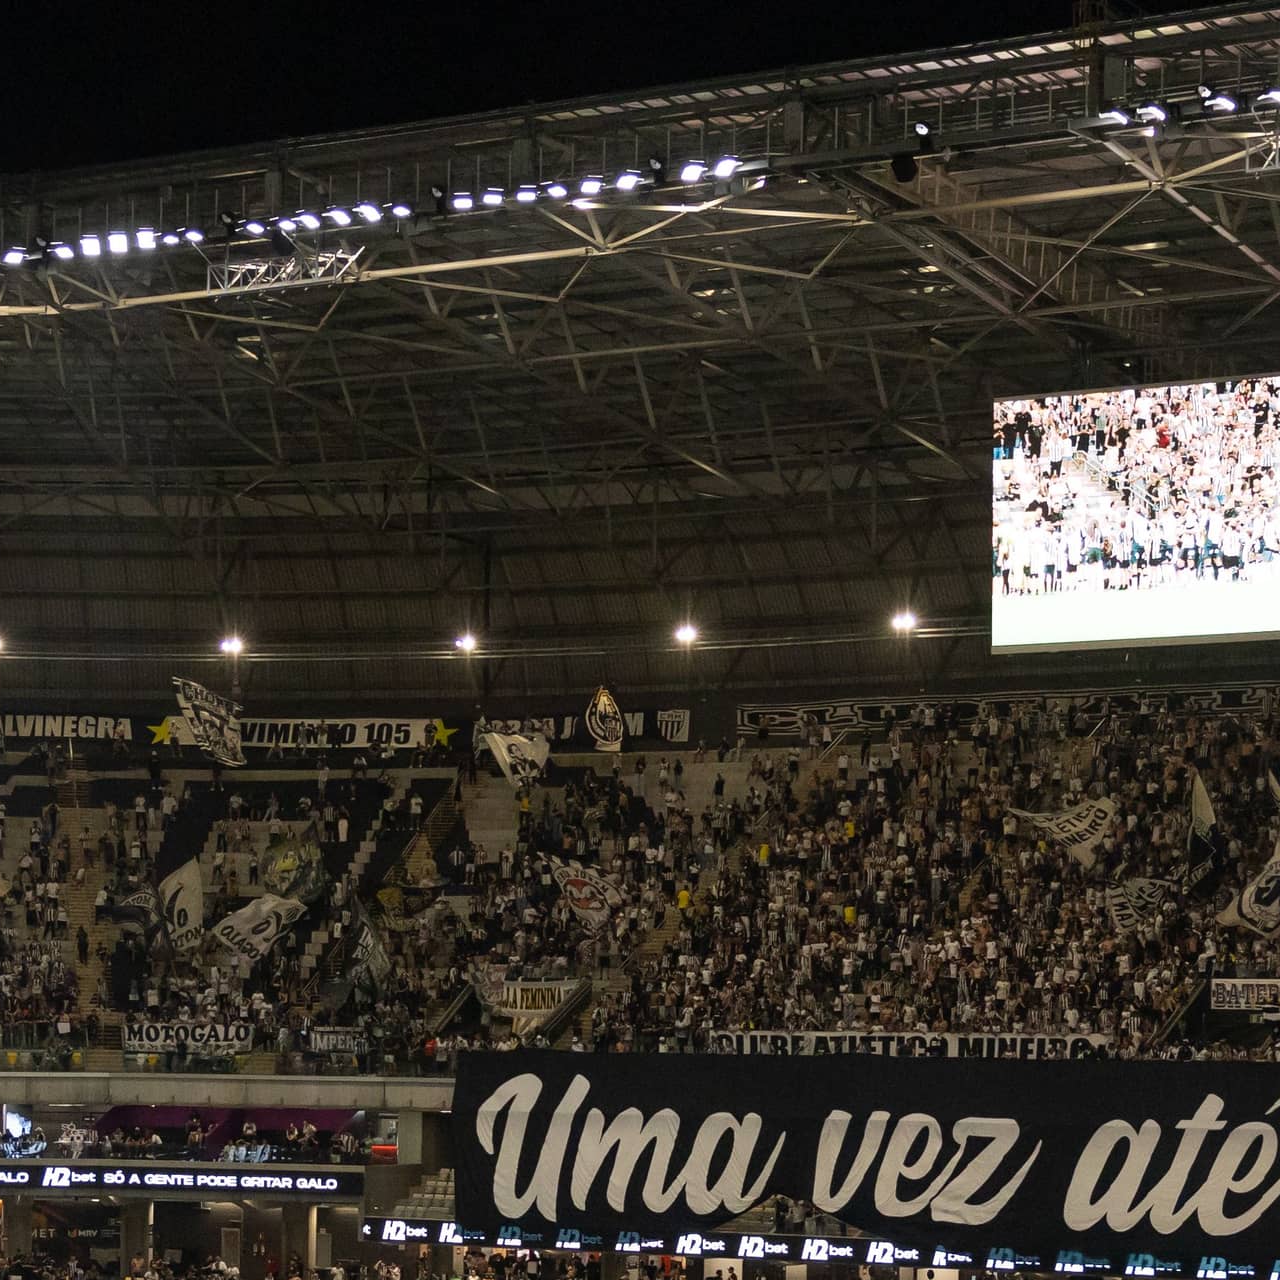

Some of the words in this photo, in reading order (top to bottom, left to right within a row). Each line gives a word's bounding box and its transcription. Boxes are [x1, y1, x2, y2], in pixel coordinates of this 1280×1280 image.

[364, 722, 411, 745] 105
[126, 1024, 250, 1045] MOTOGALO
[475, 1072, 786, 1222] Uma
[814, 1110, 1042, 1226] vez
[43, 1167, 96, 1186] H2bet
[104, 1170, 125, 1184] SÓ
[129, 1174, 140, 1184] A
[144, 1174, 193, 1186] GENTE
[197, 1175, 237, 1187] PODE
[241, 1176, 292, 1188] GRITAR
[296, 1178, 337, 1190] GALO
[382, 1220, 427, 1241] H2bet
[675, 1234, 725, 1255] H2bet
[738, 1236, 788, 1257] H2bet
[801, 1239, 853, 1260] H2bet
[866, 1242, 919, 1263] H2bet
